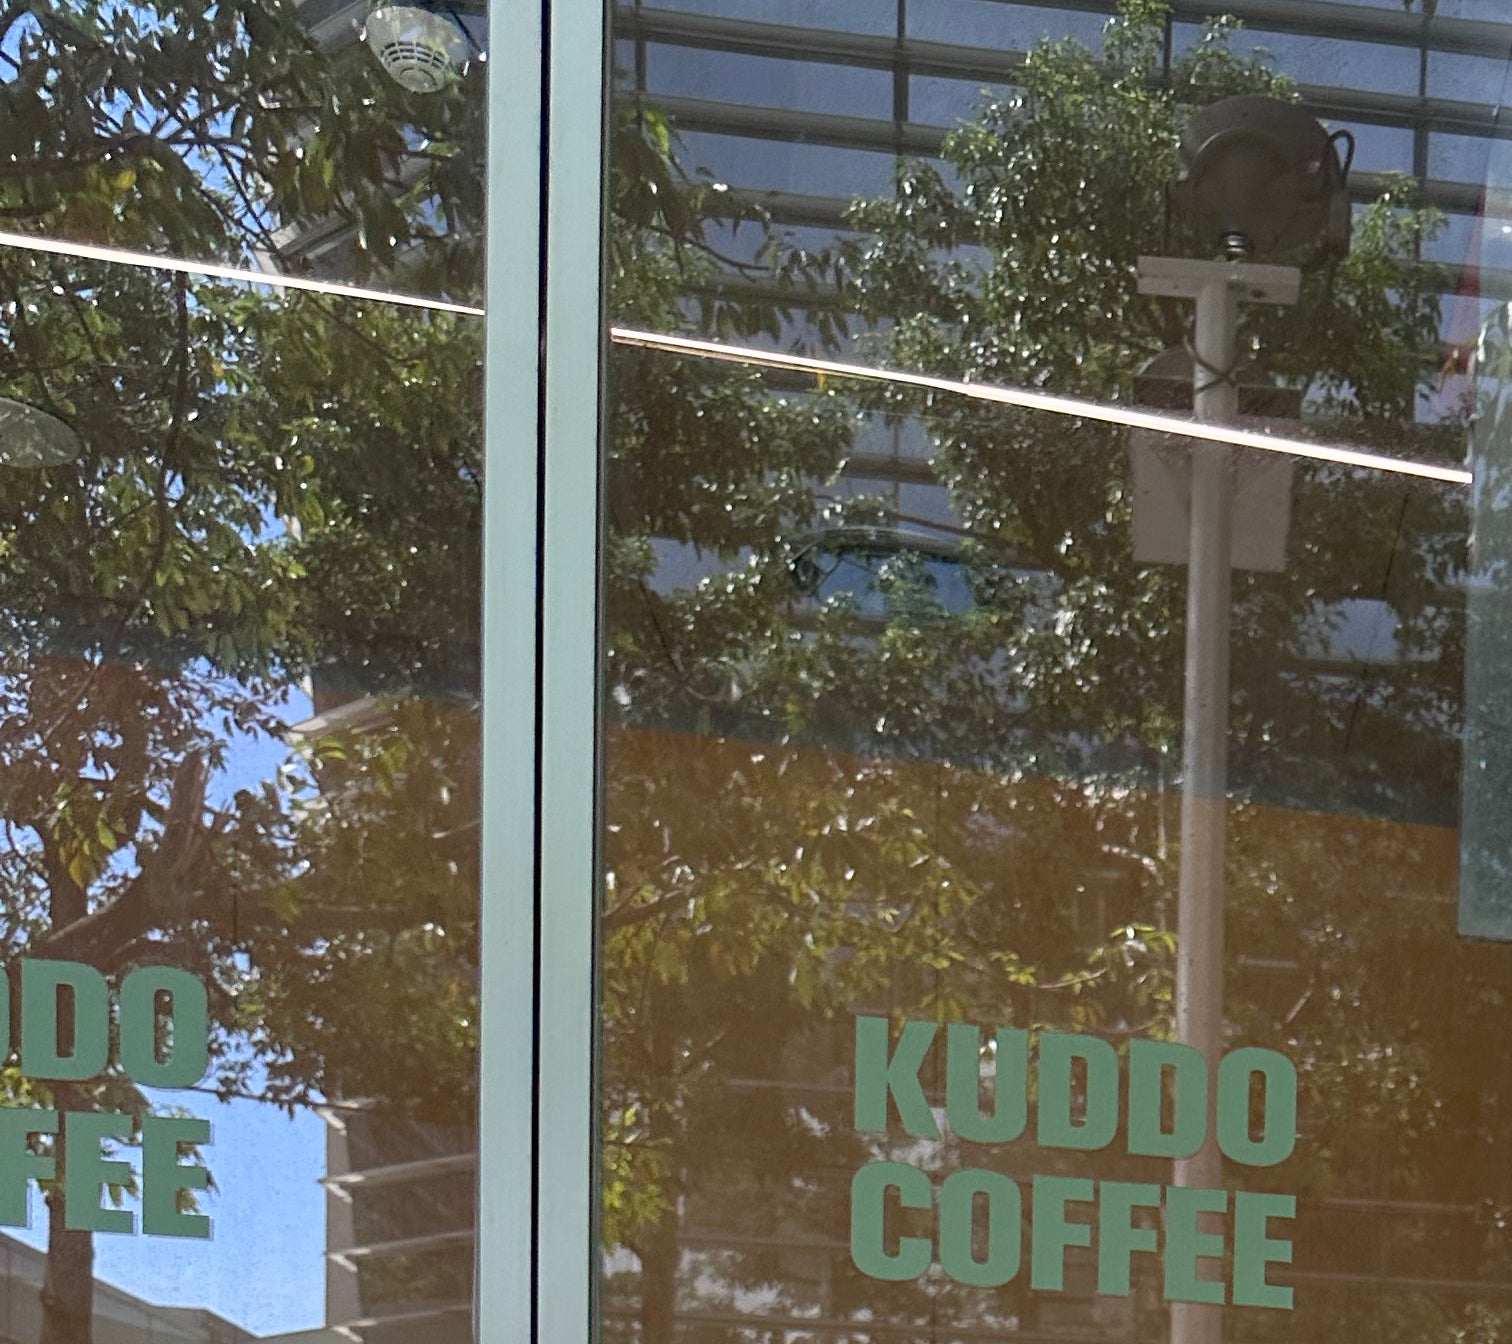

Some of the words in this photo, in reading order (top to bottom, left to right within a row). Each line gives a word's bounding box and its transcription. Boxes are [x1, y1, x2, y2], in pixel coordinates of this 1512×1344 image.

[0, 958, 209, 1089] DO
[854, 1015, 1298, 1167] KUDDO
[850, 1160, 1297, 1310] COFFEE
